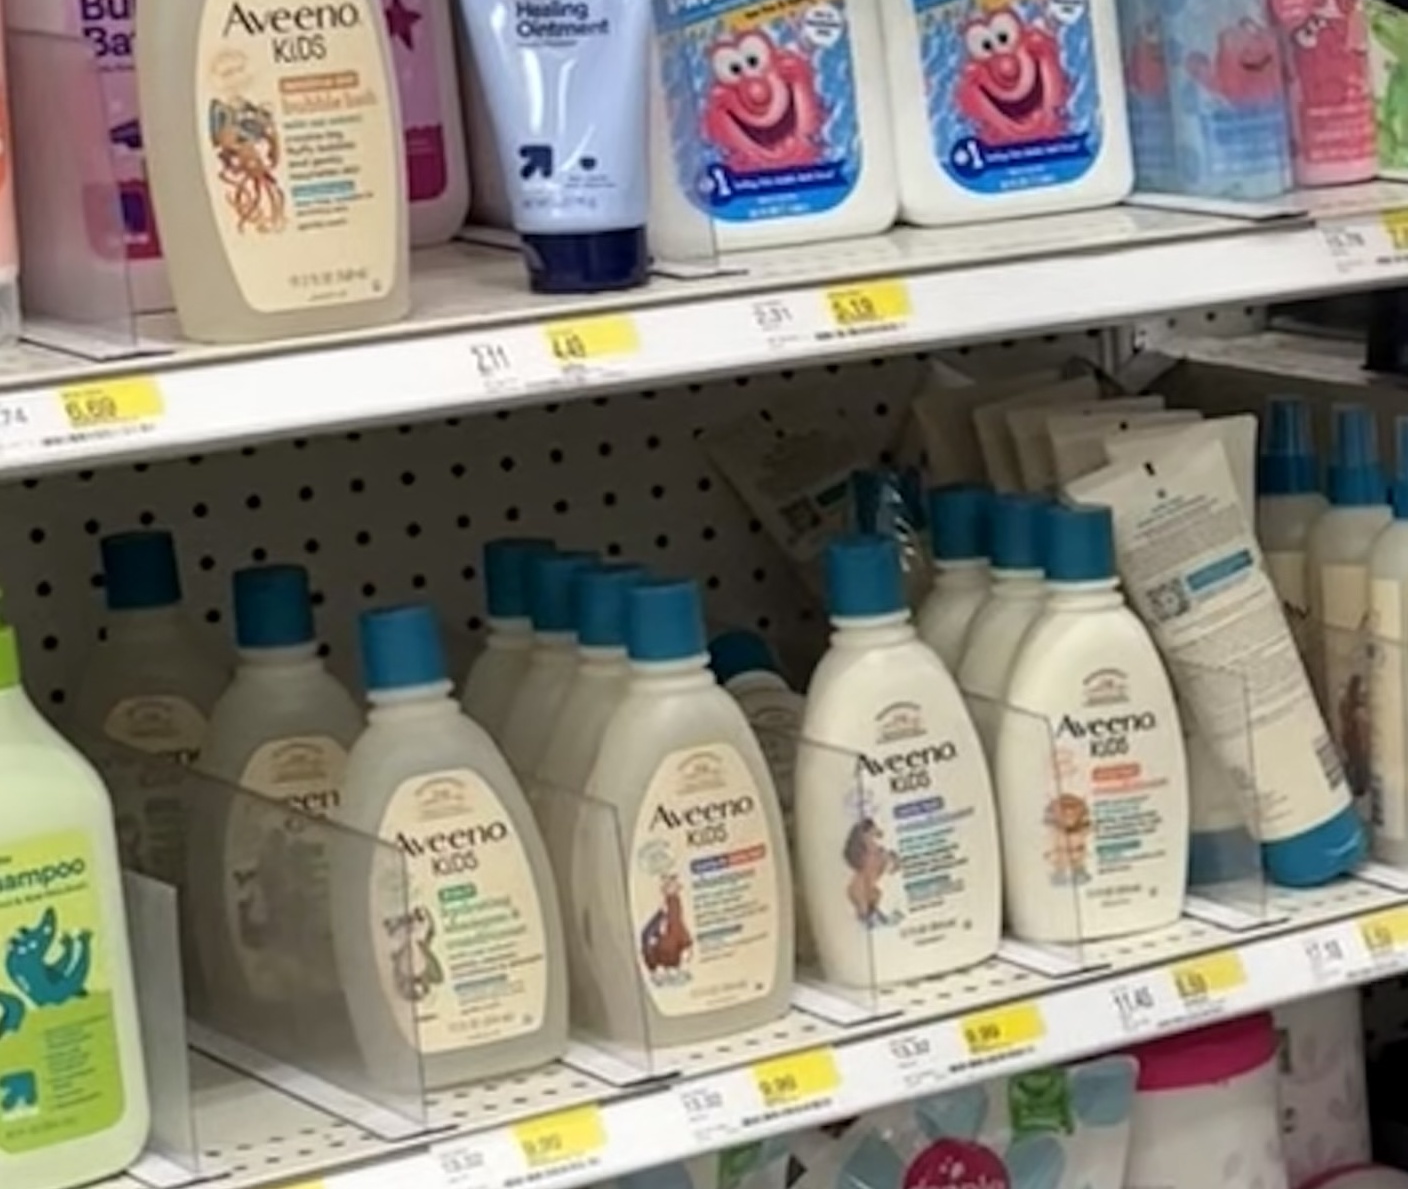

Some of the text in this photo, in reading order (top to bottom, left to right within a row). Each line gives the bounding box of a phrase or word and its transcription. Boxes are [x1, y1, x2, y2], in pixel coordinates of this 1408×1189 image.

[223, 0, 359, 38] Aveeno
[516, 1, 588, 20] Healing
[516, 19, 609, 38] Ointment
[1056, 712, 1157, 738] Aveeno
[855, 739, 957, 779] Aveeno
[649, 795, 755, 832] Aveeno
[397, 820, 508, 857] Aveeno
[0, 858, 86, 893] ampoo
